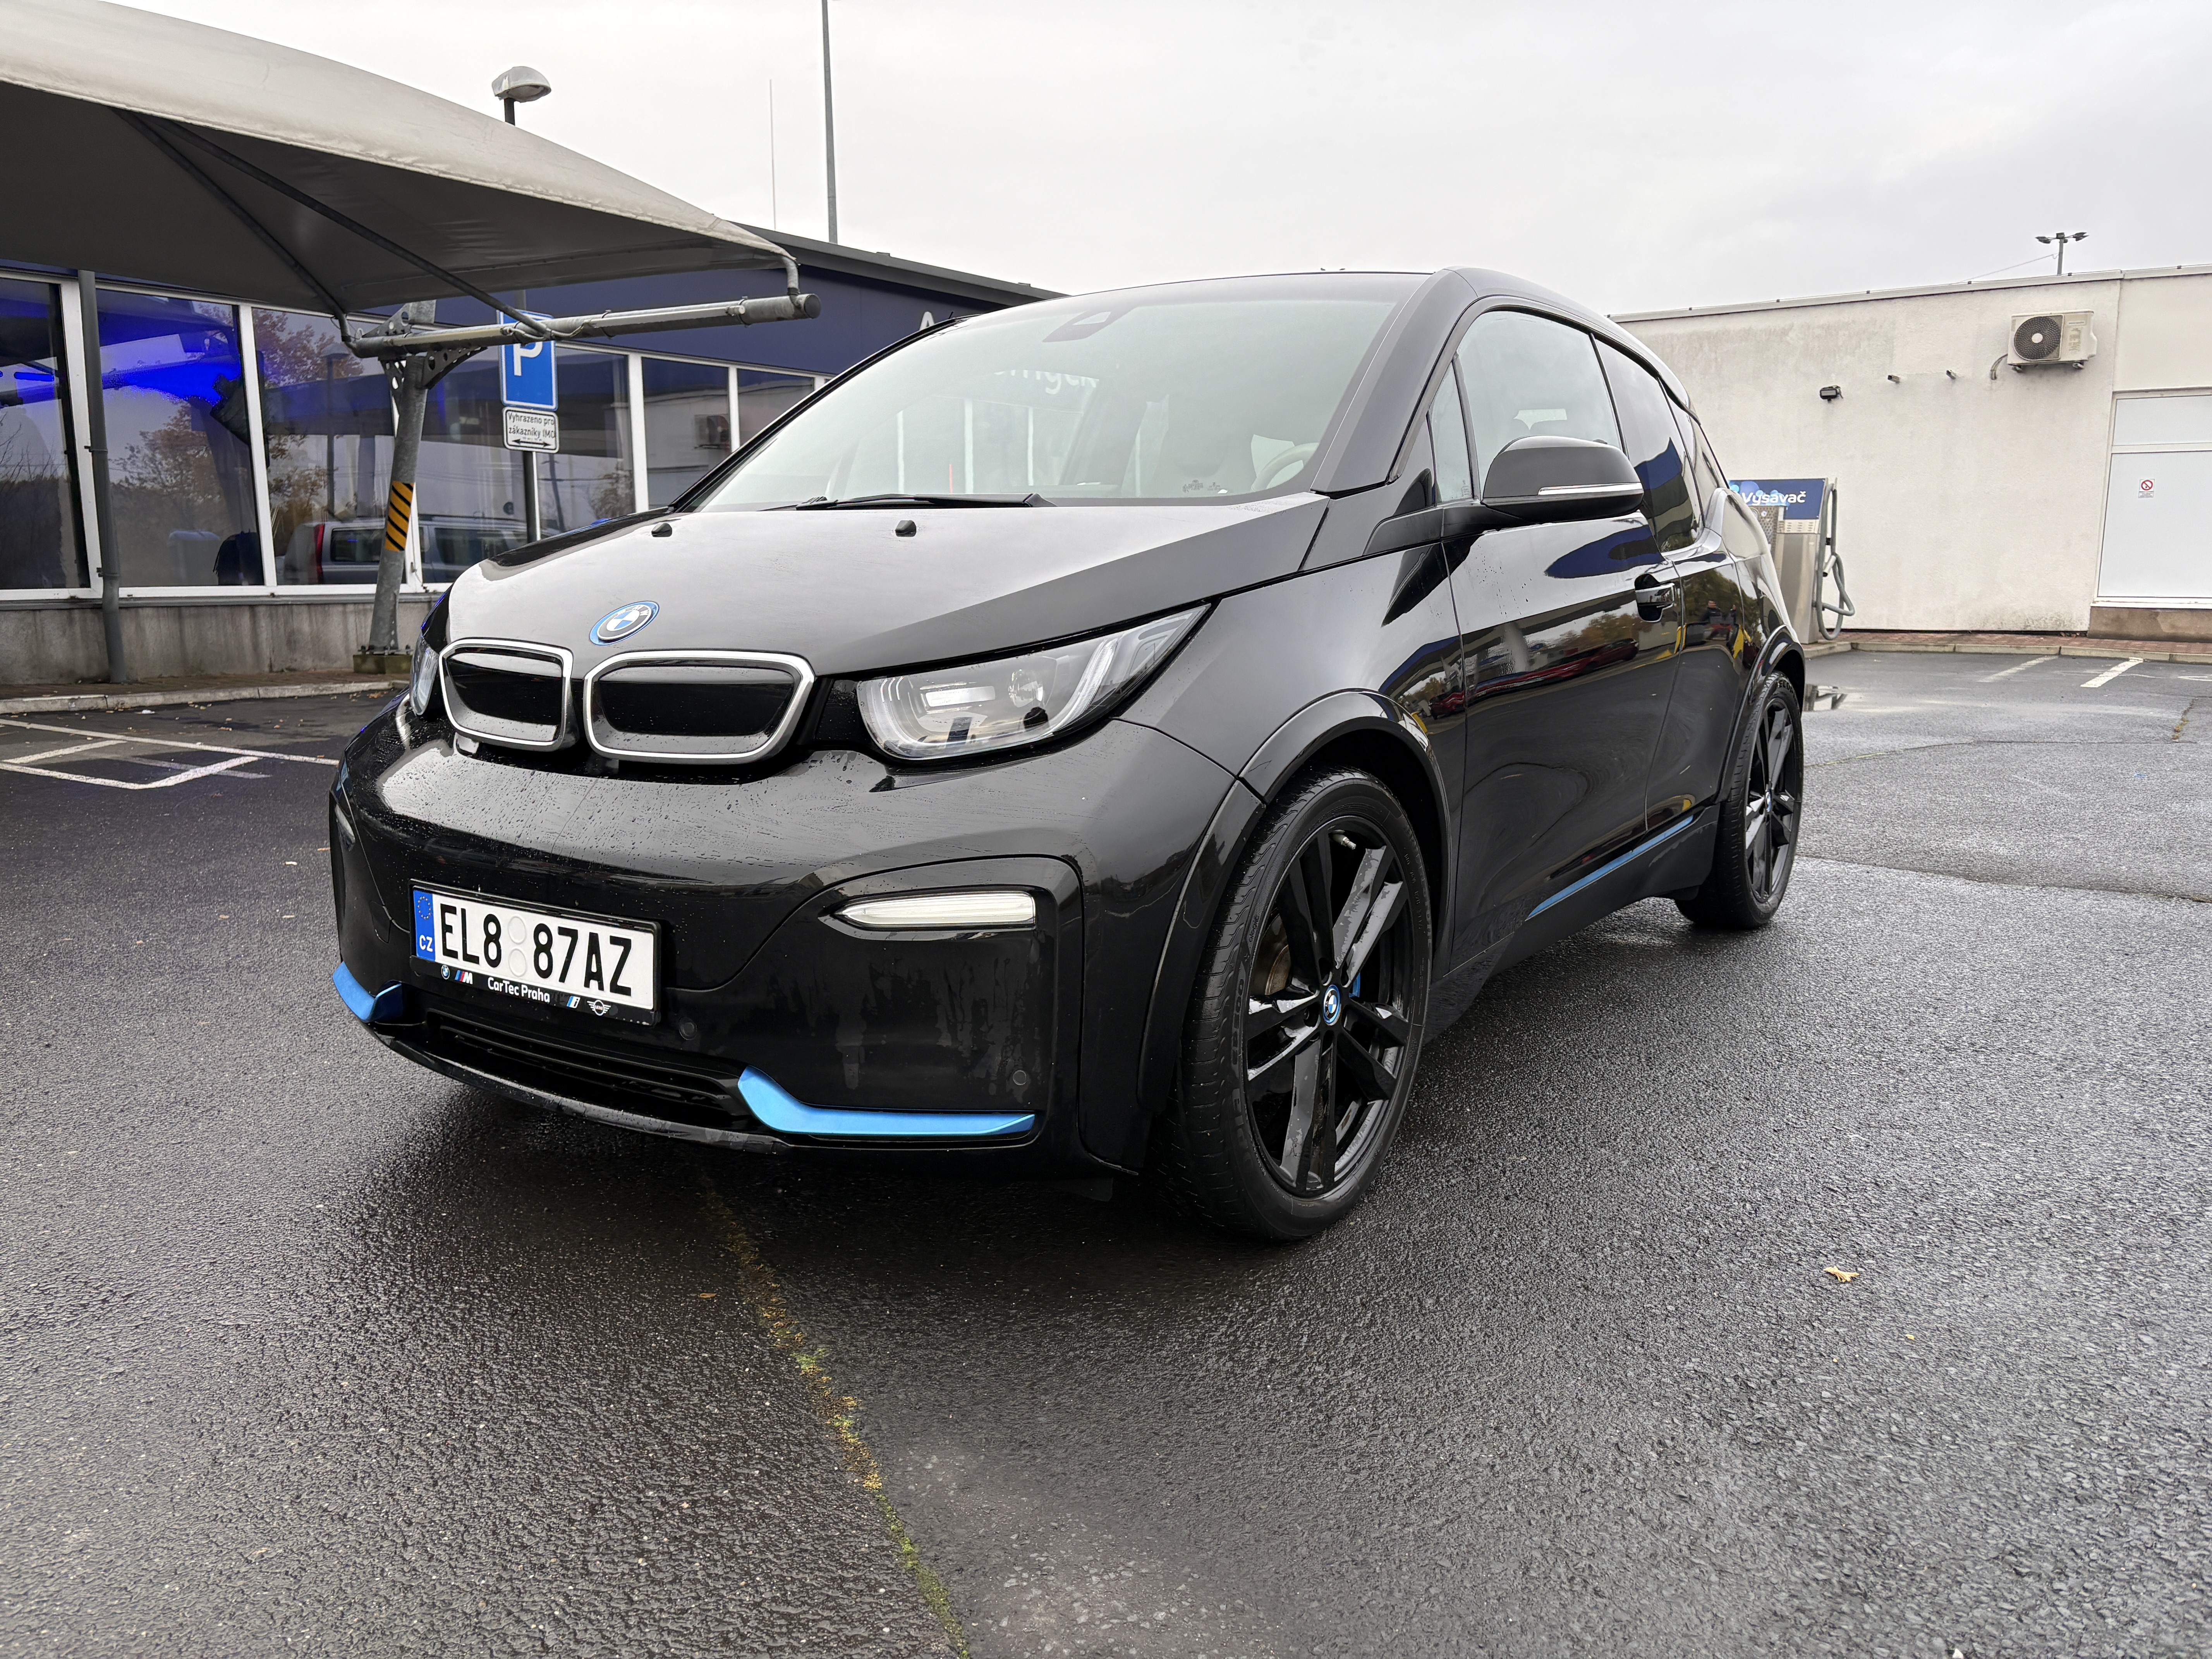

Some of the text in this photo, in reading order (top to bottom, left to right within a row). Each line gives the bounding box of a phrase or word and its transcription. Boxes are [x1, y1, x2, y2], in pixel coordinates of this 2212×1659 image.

[513, 341, 543, 376] P
[508, 412, 555, 426] Vyhrazeno pro
[508, 424, 541, 438] zákazníky
[1741, 491, 1806, 505] Vysavač
[419, 934, 433, 952] CZ
[440, 903, 632, 996] EL8 87AZ
[488, 977, 550, 1003] CarTec Praha
